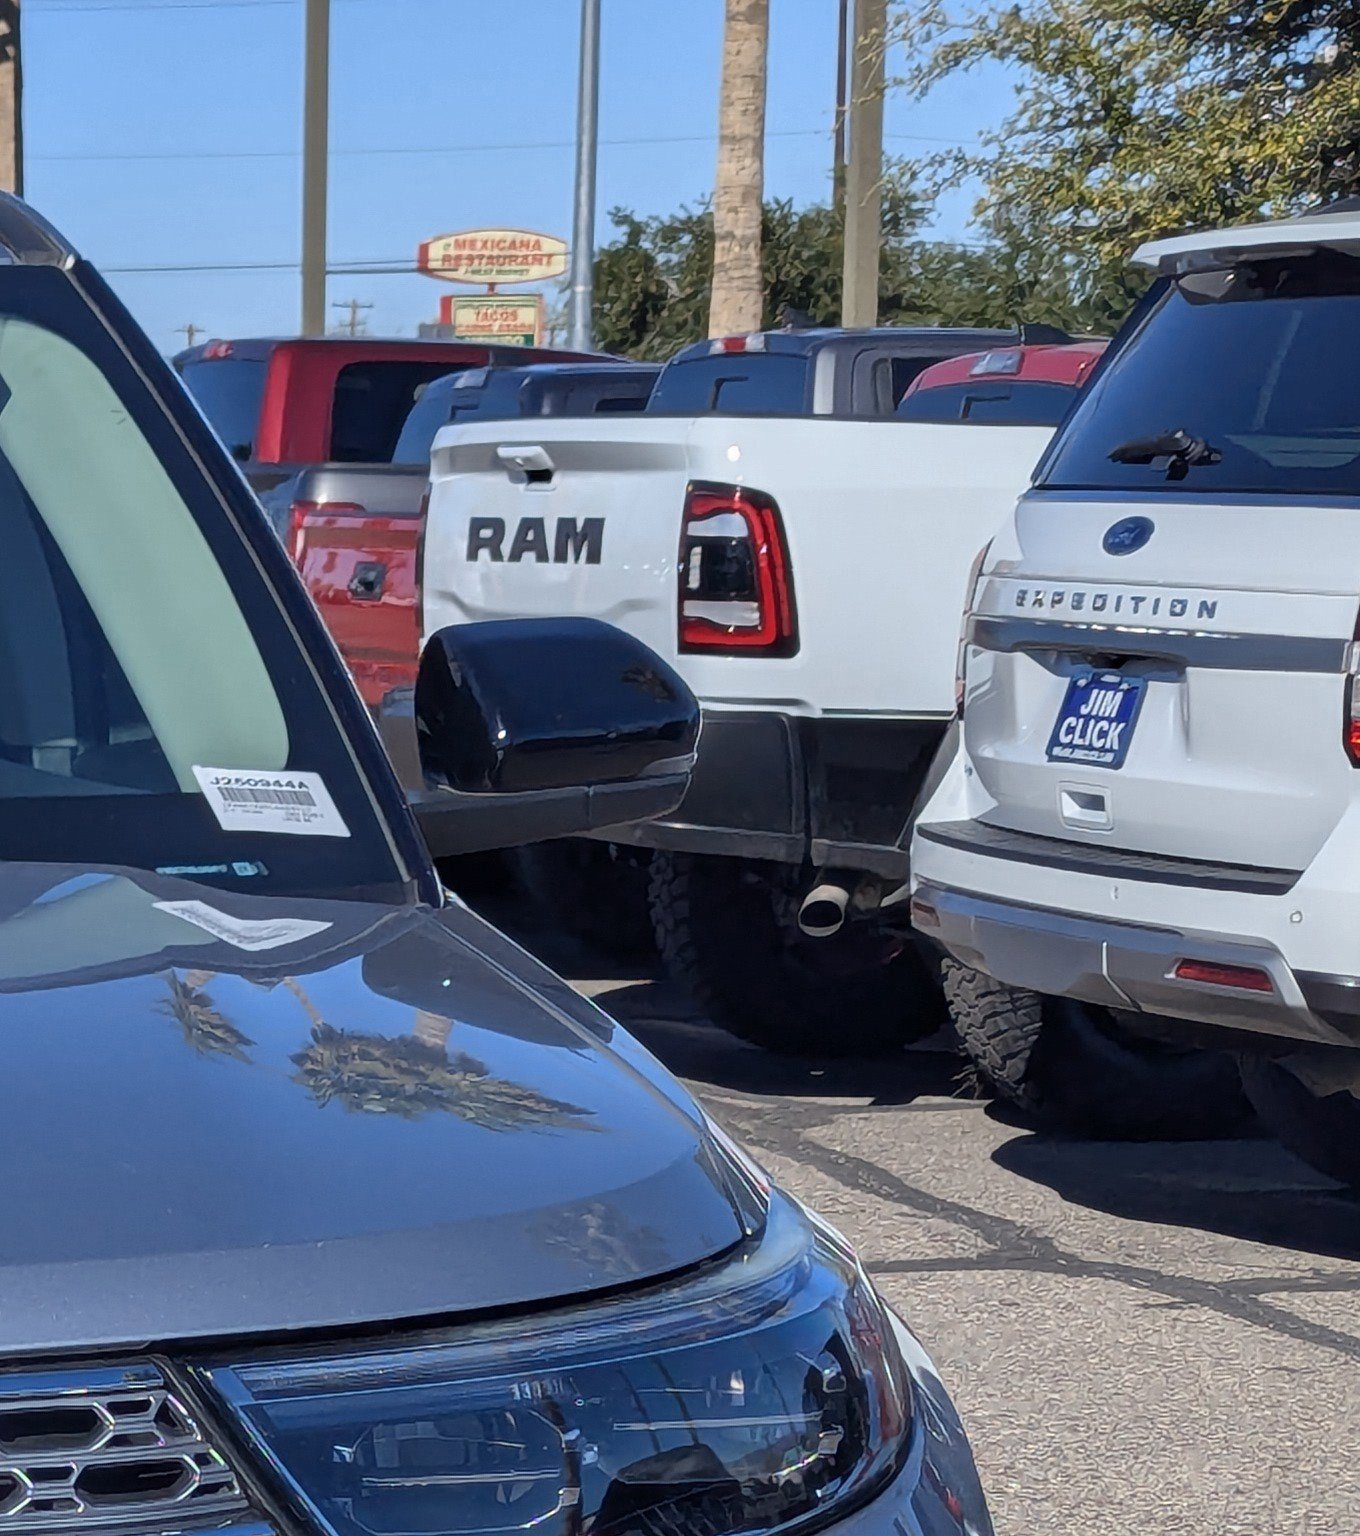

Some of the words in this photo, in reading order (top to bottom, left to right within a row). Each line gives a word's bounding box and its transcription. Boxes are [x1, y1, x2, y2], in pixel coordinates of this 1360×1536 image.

[453, 238, 542, 251] MEXICANA
[441, 253, 553, 267] RESTAURANT
[466, 516, 606, 565] RAM
[1016, 589, 1218, 619] EXPEDITION
[1080, 689, 1124, 718] JIM
[1059, 716, 1126, 750] CLICK
